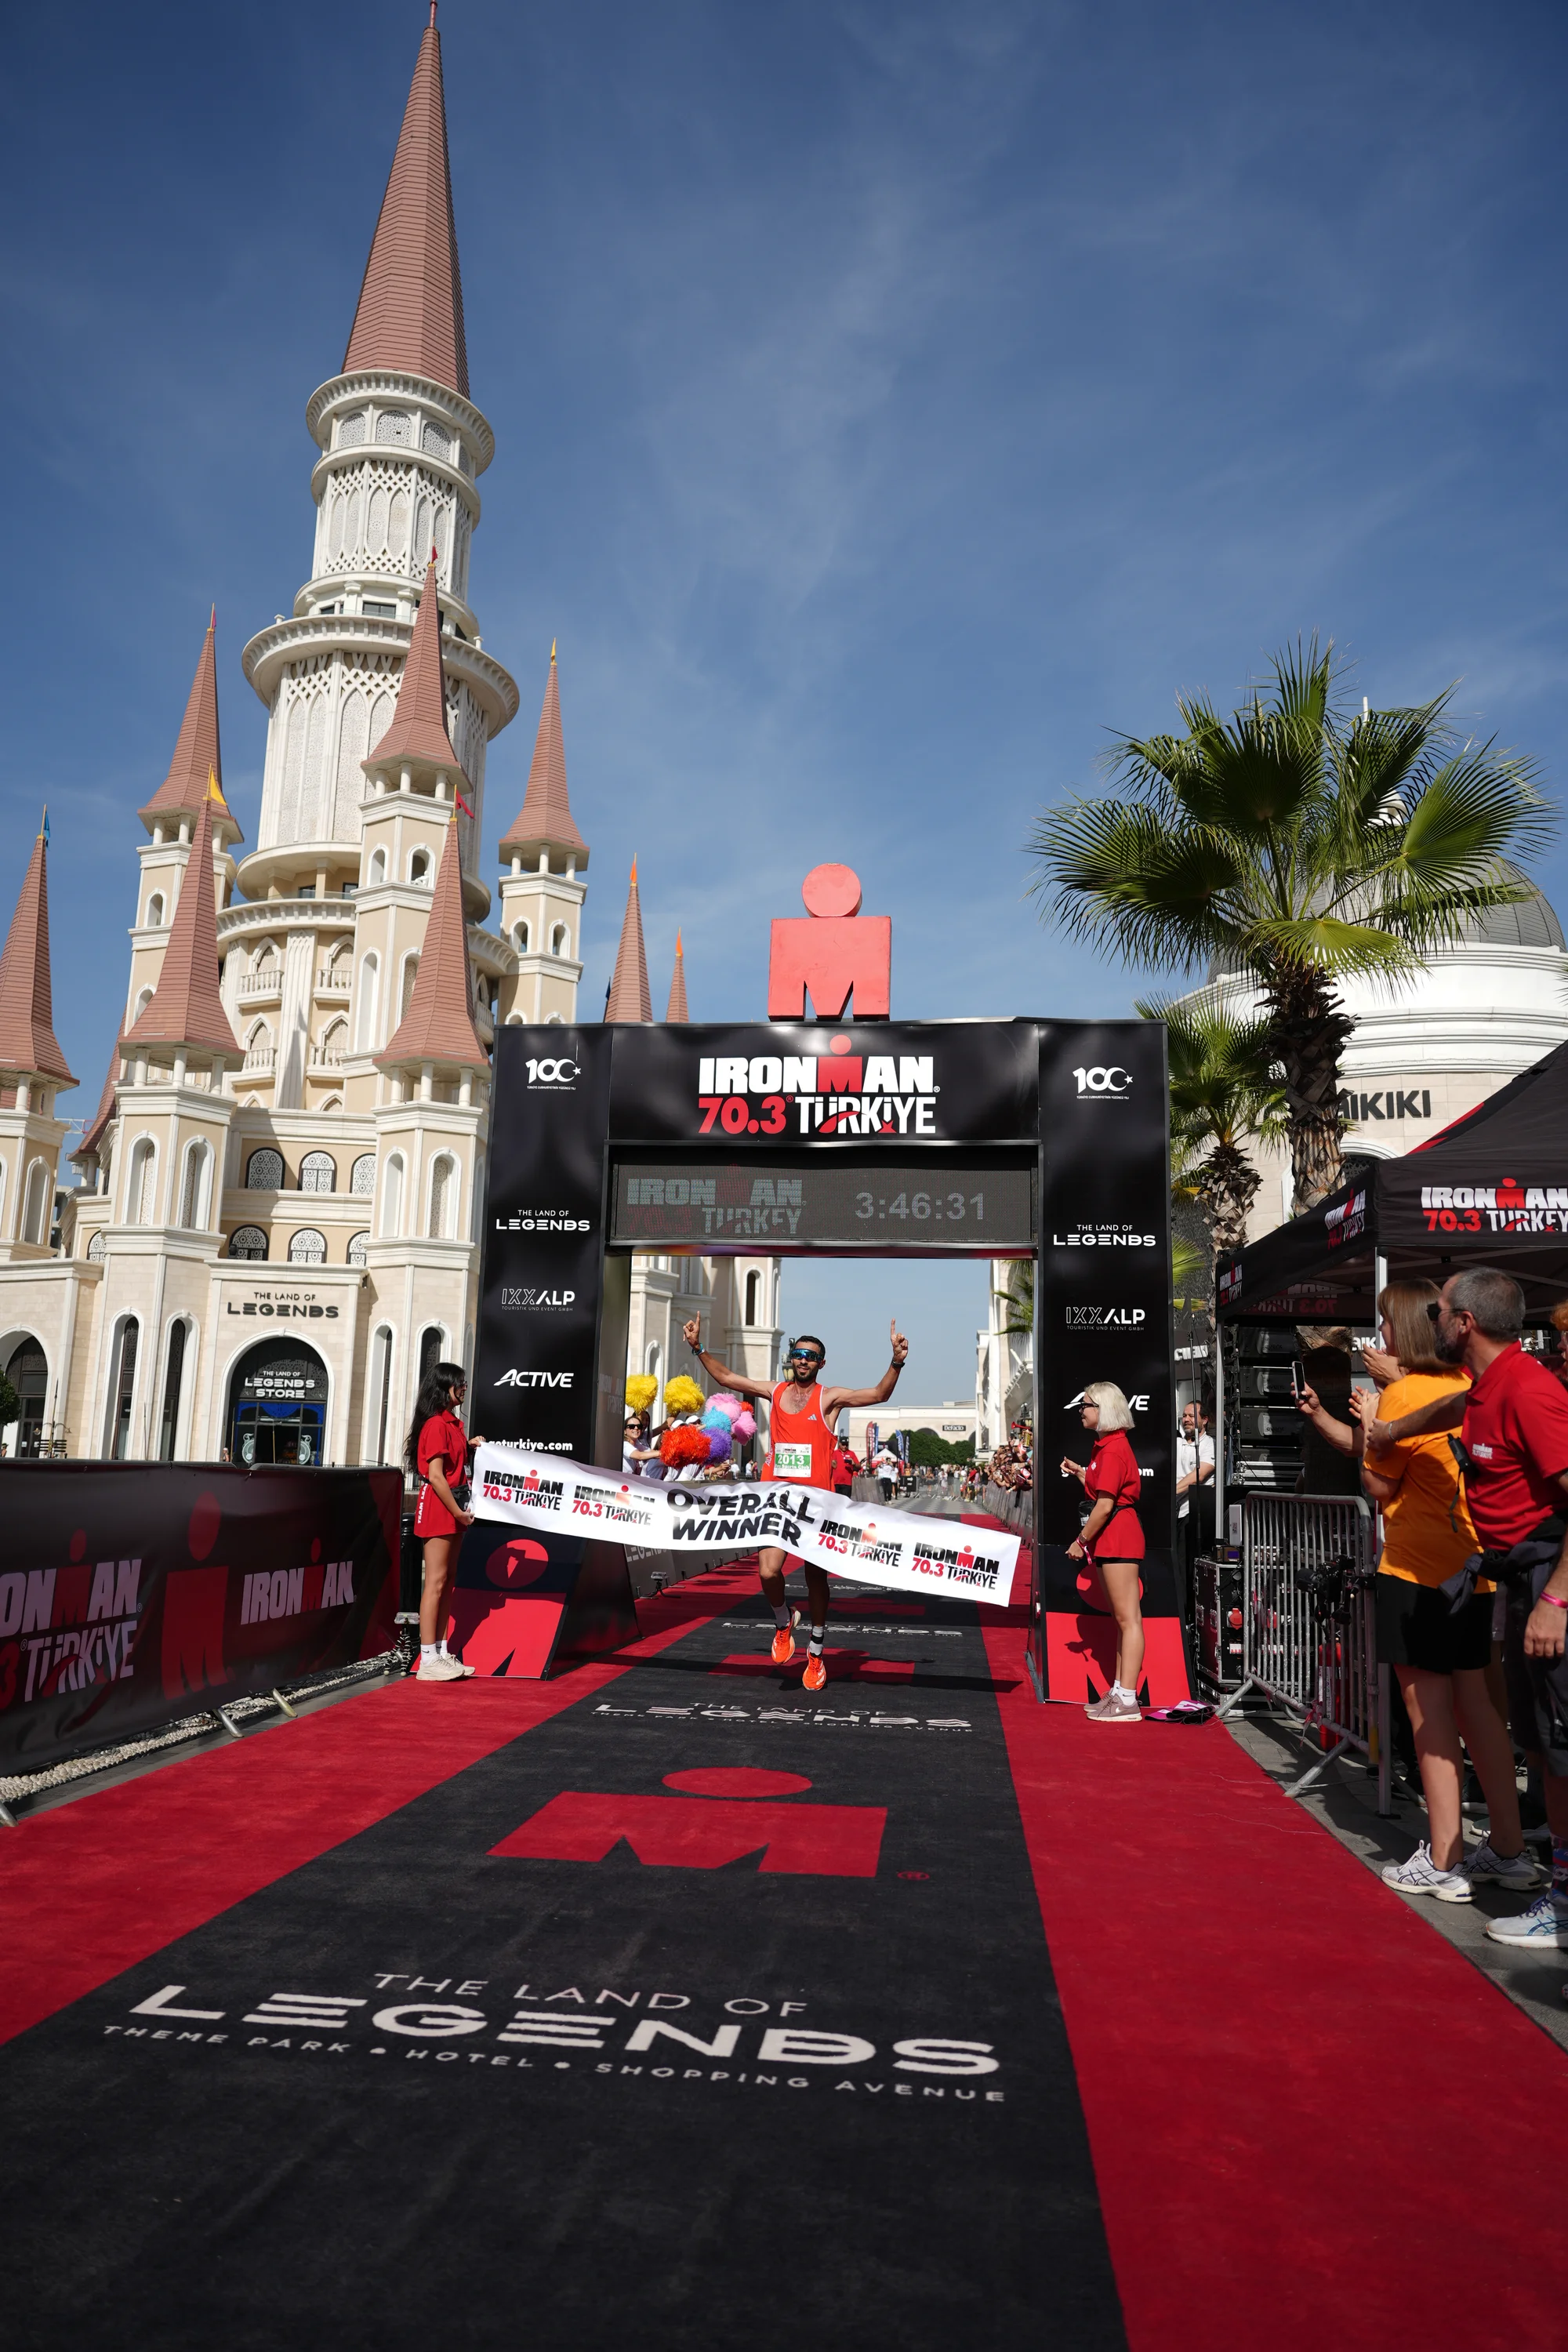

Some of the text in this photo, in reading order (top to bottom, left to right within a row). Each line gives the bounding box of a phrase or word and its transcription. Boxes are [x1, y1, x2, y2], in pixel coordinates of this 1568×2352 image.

[699, 1035, 934, 1094] IRONMAN
[699, 1096, 786, 1134] 70.3
[1338, 1090, 1432, 1121] AIKIKI
[855, 1192, 985, 1220] 3:46:31
[1421, 1178, 1568, 1209] IRONMAN
[495, 1218, 590, 1232] LEGENDS
[702, 1207, 802, 1234] TURKEY
[1423, 1210, 1482, 1232] 70.3
[1054, 1234, 1156, 1247] LEGENDS
[274, 1292, 299, 1301] LAND
[227, 1301, 339, 1319] LEGENDS
[245, 1377, 315, 1388] LEGENDS
[493, 1369, 574, 1388] ACTIVE
[256, 1389, 305, 1399] STORE
[778, 1454, 804, 1465] 2013
[483, 1485, 513, 1502] 70.3
[484, 1469, 564, 1496] IRONMAN
[572, 1500, 602, 1518] 70.3
[666, 1488, 815, 1524] OVERALL
[673, 1513, 801, 1548] WINNER
[818, 1534, 848, 1554] 70.3
[911, 1557, 944, 1577] 70.3
[914, 1542, 1000, 1574] IRONMAN
[0, 1529, 142, 1638] ONMAN
[241, 1537, 354, 1625] IRONMAN
[595, 1704, 972, 1728] LEGENDS
[690, 1702, 743, 1711] THE
[373, 1973, 808, 2017] THE LAND OF
[129, 1985, 1000, 2075] LEGENDS
[103, 2025, 1005, 2103] THEME PARK HOTEL SHOPPING AVENUE
